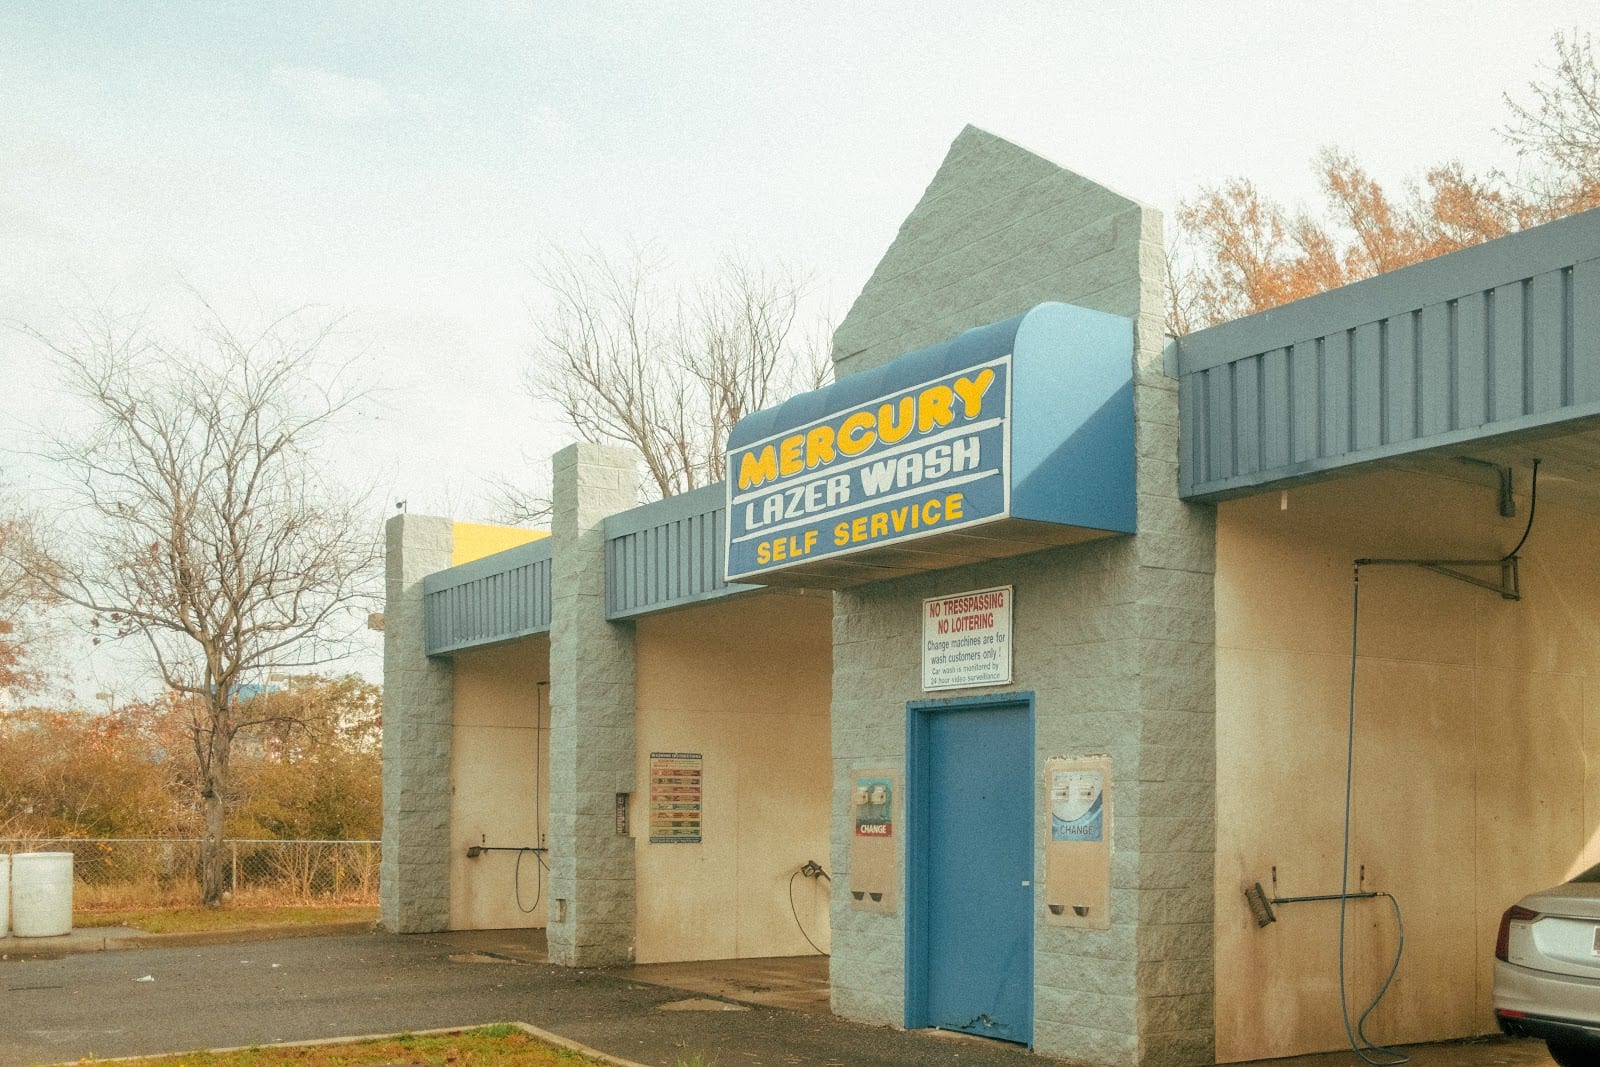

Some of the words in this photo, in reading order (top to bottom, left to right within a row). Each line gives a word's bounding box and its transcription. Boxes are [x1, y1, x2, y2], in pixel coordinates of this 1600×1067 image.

[738, 369, 995, 490] MERCURY
[745, 474, 851, 530] LAZER
[861, 436, 981, 496] WASH
[757, 530, 818, 565] SELF
[834, 493, 964, 546] SERVICE
[929, 602, 941, 618] NO
[944, 592, 1004, 616] TRESSPASSING
[937, 620, 949, 634] NO
[951, 612, 994, 633] LOITERING
[927, 639, 950, 651] Change
[951, 636, 981, 648] machines
[983, 636, 994, 645] are
[996, 631, 1006, 643] for
[931, 653, 947, 664] wash
[948, 651, 981, 663] customers
[982, 648, 997, 660] only
[860, 824, 887, 834] CHANGE
[1060, 825, 1094, 835] CHANGE
